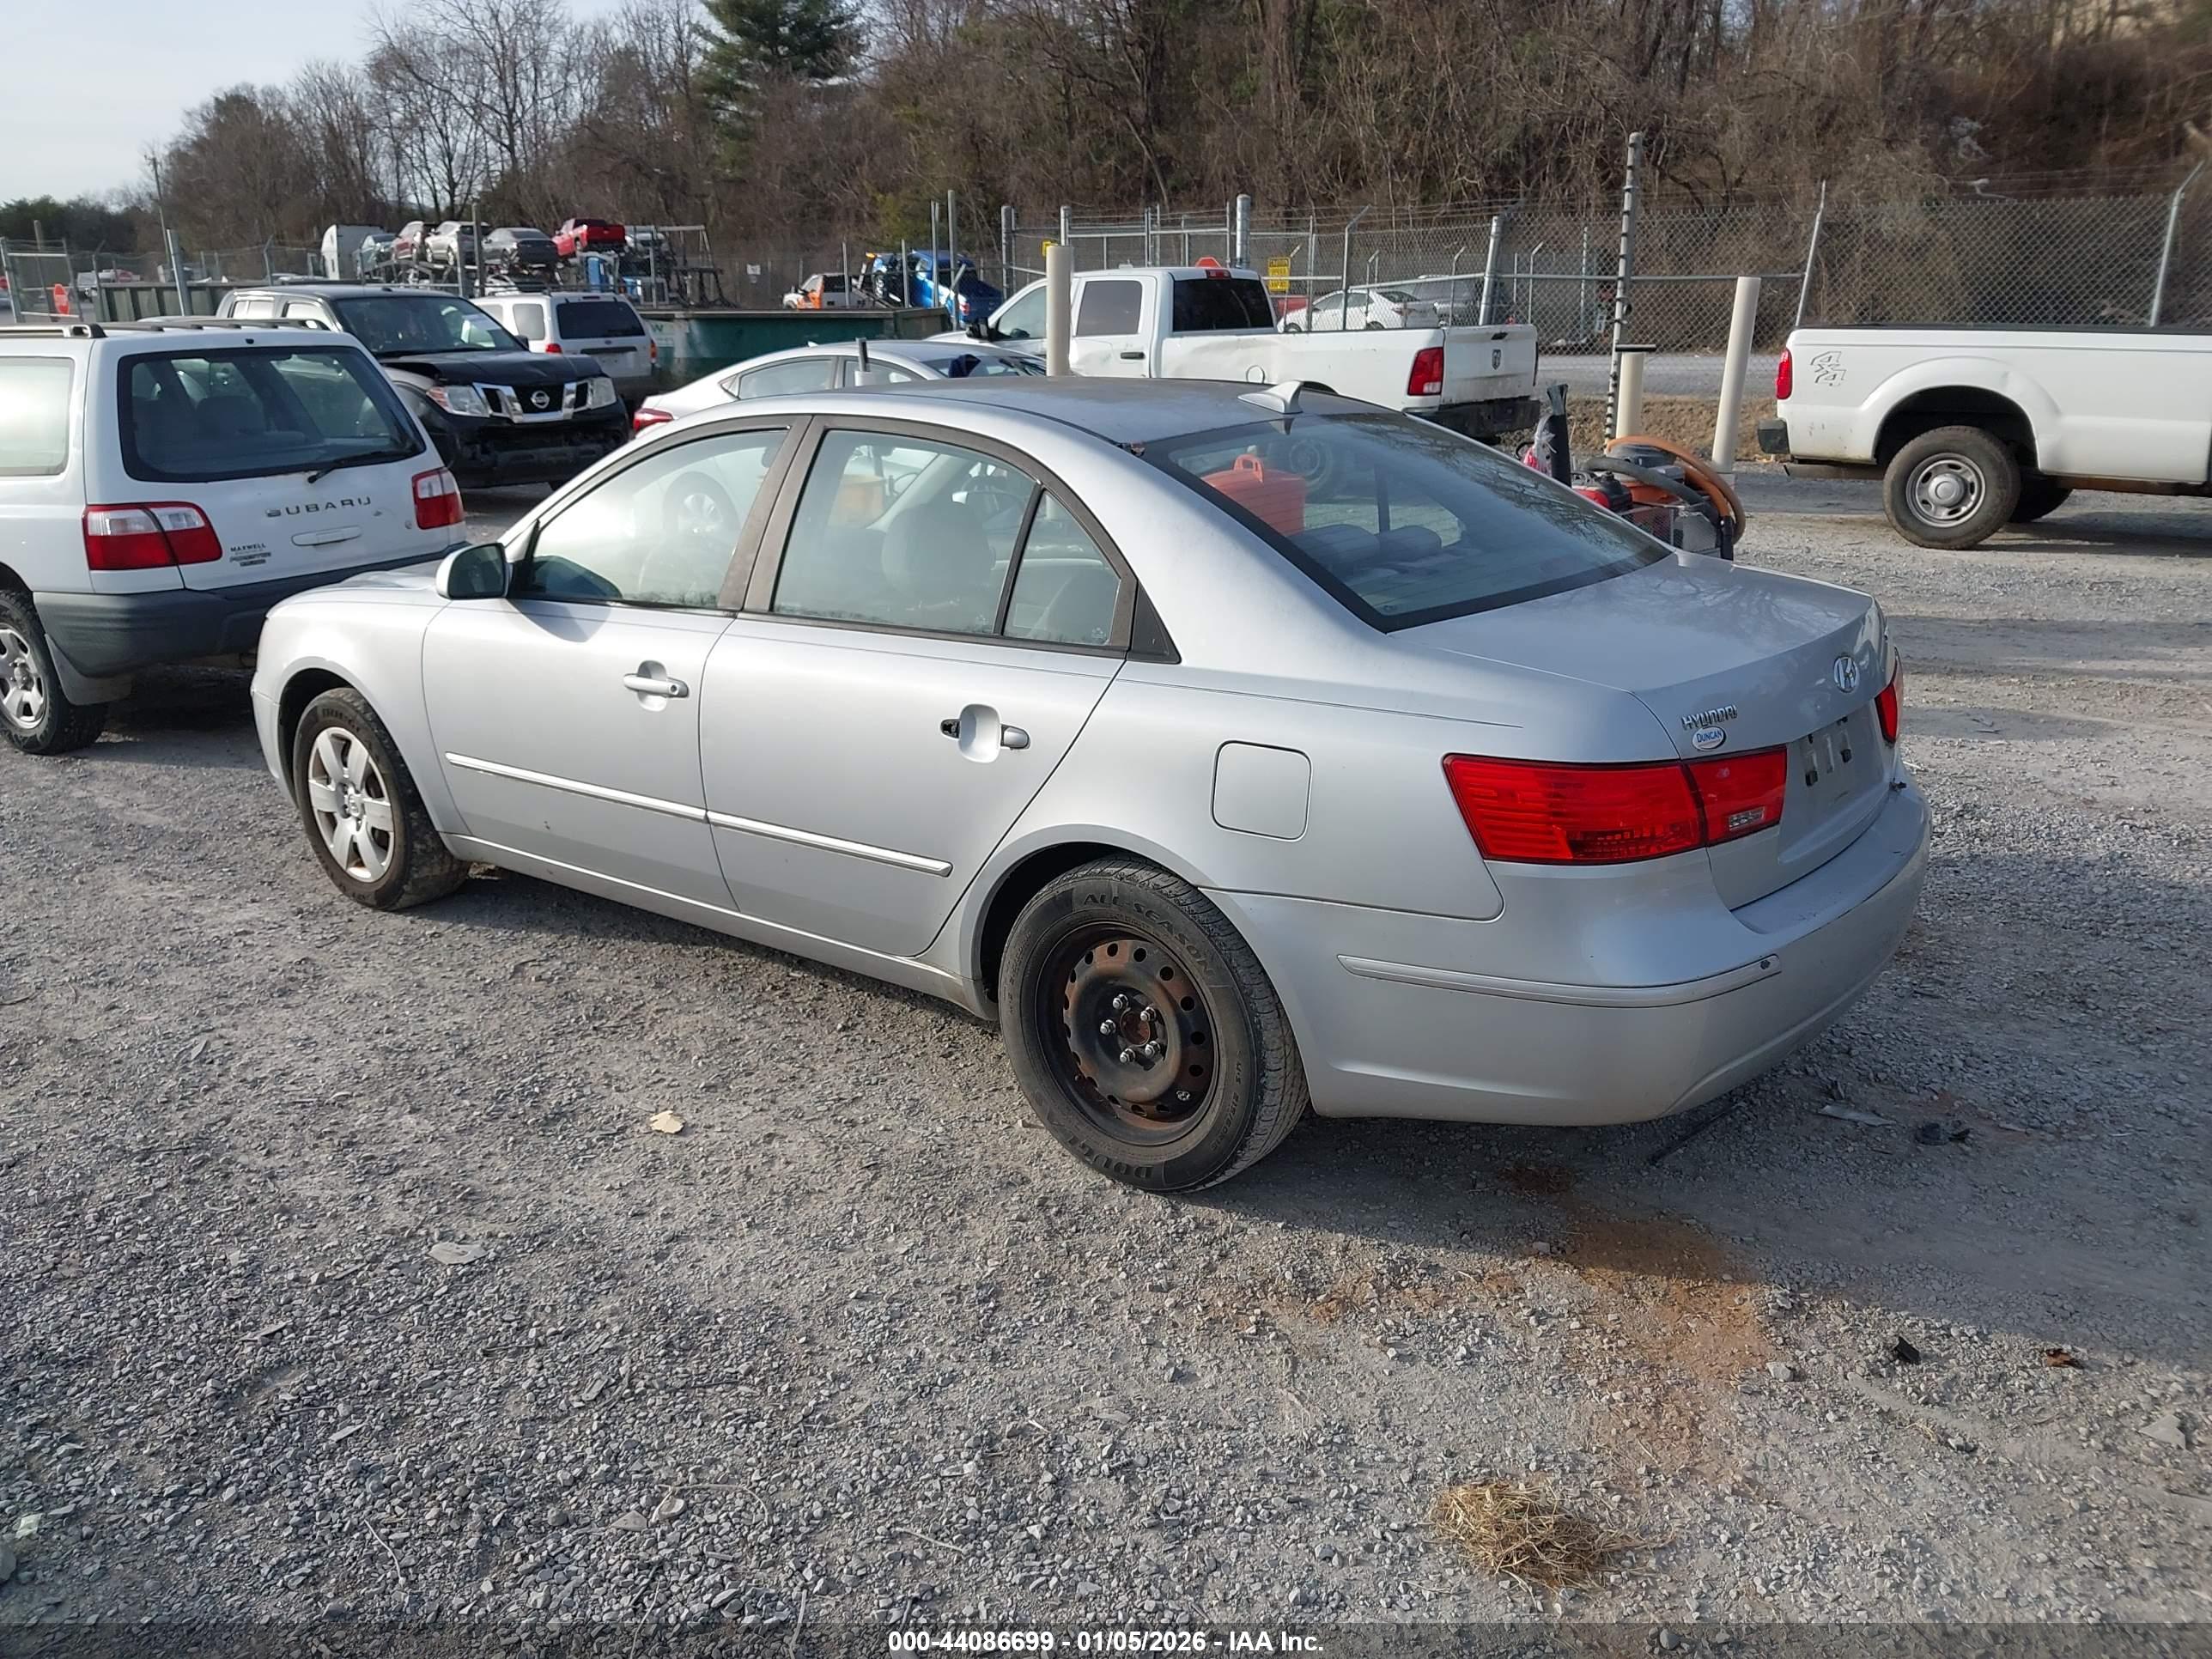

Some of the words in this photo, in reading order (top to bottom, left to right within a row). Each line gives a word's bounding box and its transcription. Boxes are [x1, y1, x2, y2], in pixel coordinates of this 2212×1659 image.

[265, 495, 372, 517] SUBARU
[230, 543, 266, 552] MAXWELL
[1681, 704, 1737, 730] HYUNDAI
[1696, 729, 1723, 744] DUNCAN
